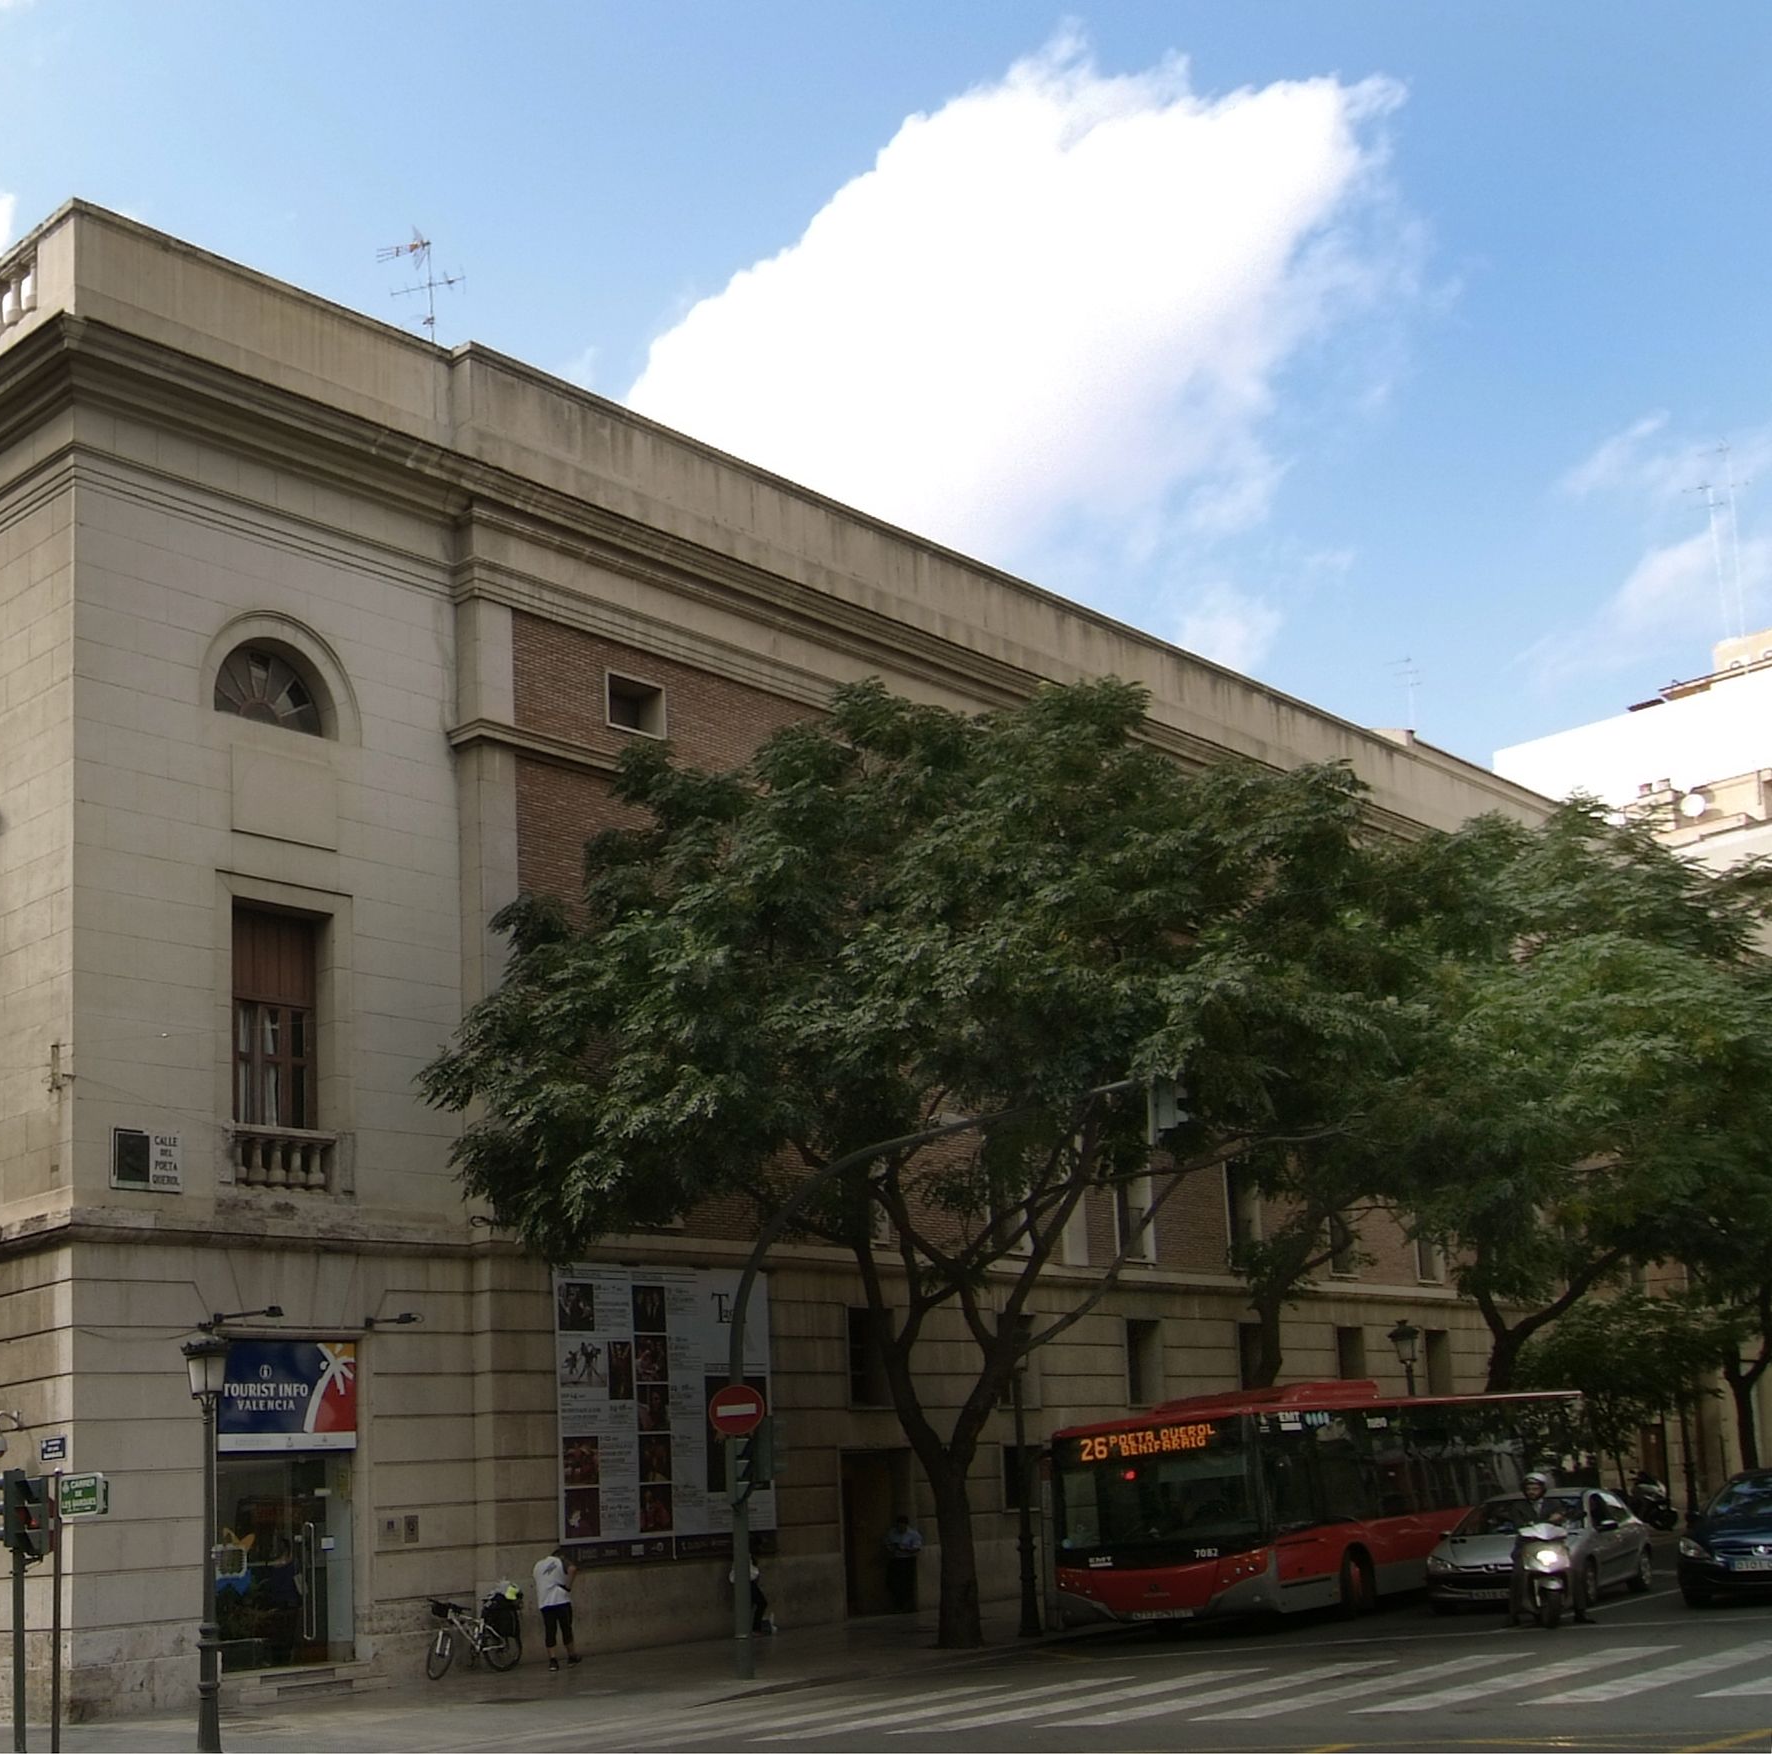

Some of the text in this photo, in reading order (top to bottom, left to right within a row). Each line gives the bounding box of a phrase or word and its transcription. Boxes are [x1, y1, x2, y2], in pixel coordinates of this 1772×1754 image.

[154, 1135, 178, 1147] CALLE
[160, 1148, 173, 1157] DEL
[154, 1160, 178, 1171] POETA
[152, 1174, 180, 1186] QUEROL
[224, 1383, 308, 1397] TOURIST INFO
[236, 1400, 295, 1411] VALENCIA
[1279, 1411, 1300, 1421] EMT
[1109, 1424, 1216, 1447] POETA QUEROL
[1080, 1437, 1108, 1461] 26
[1121, 1436, 1207, 1456] BENIFARAIG
[1194, 1548, 1219, 1558] 7082
